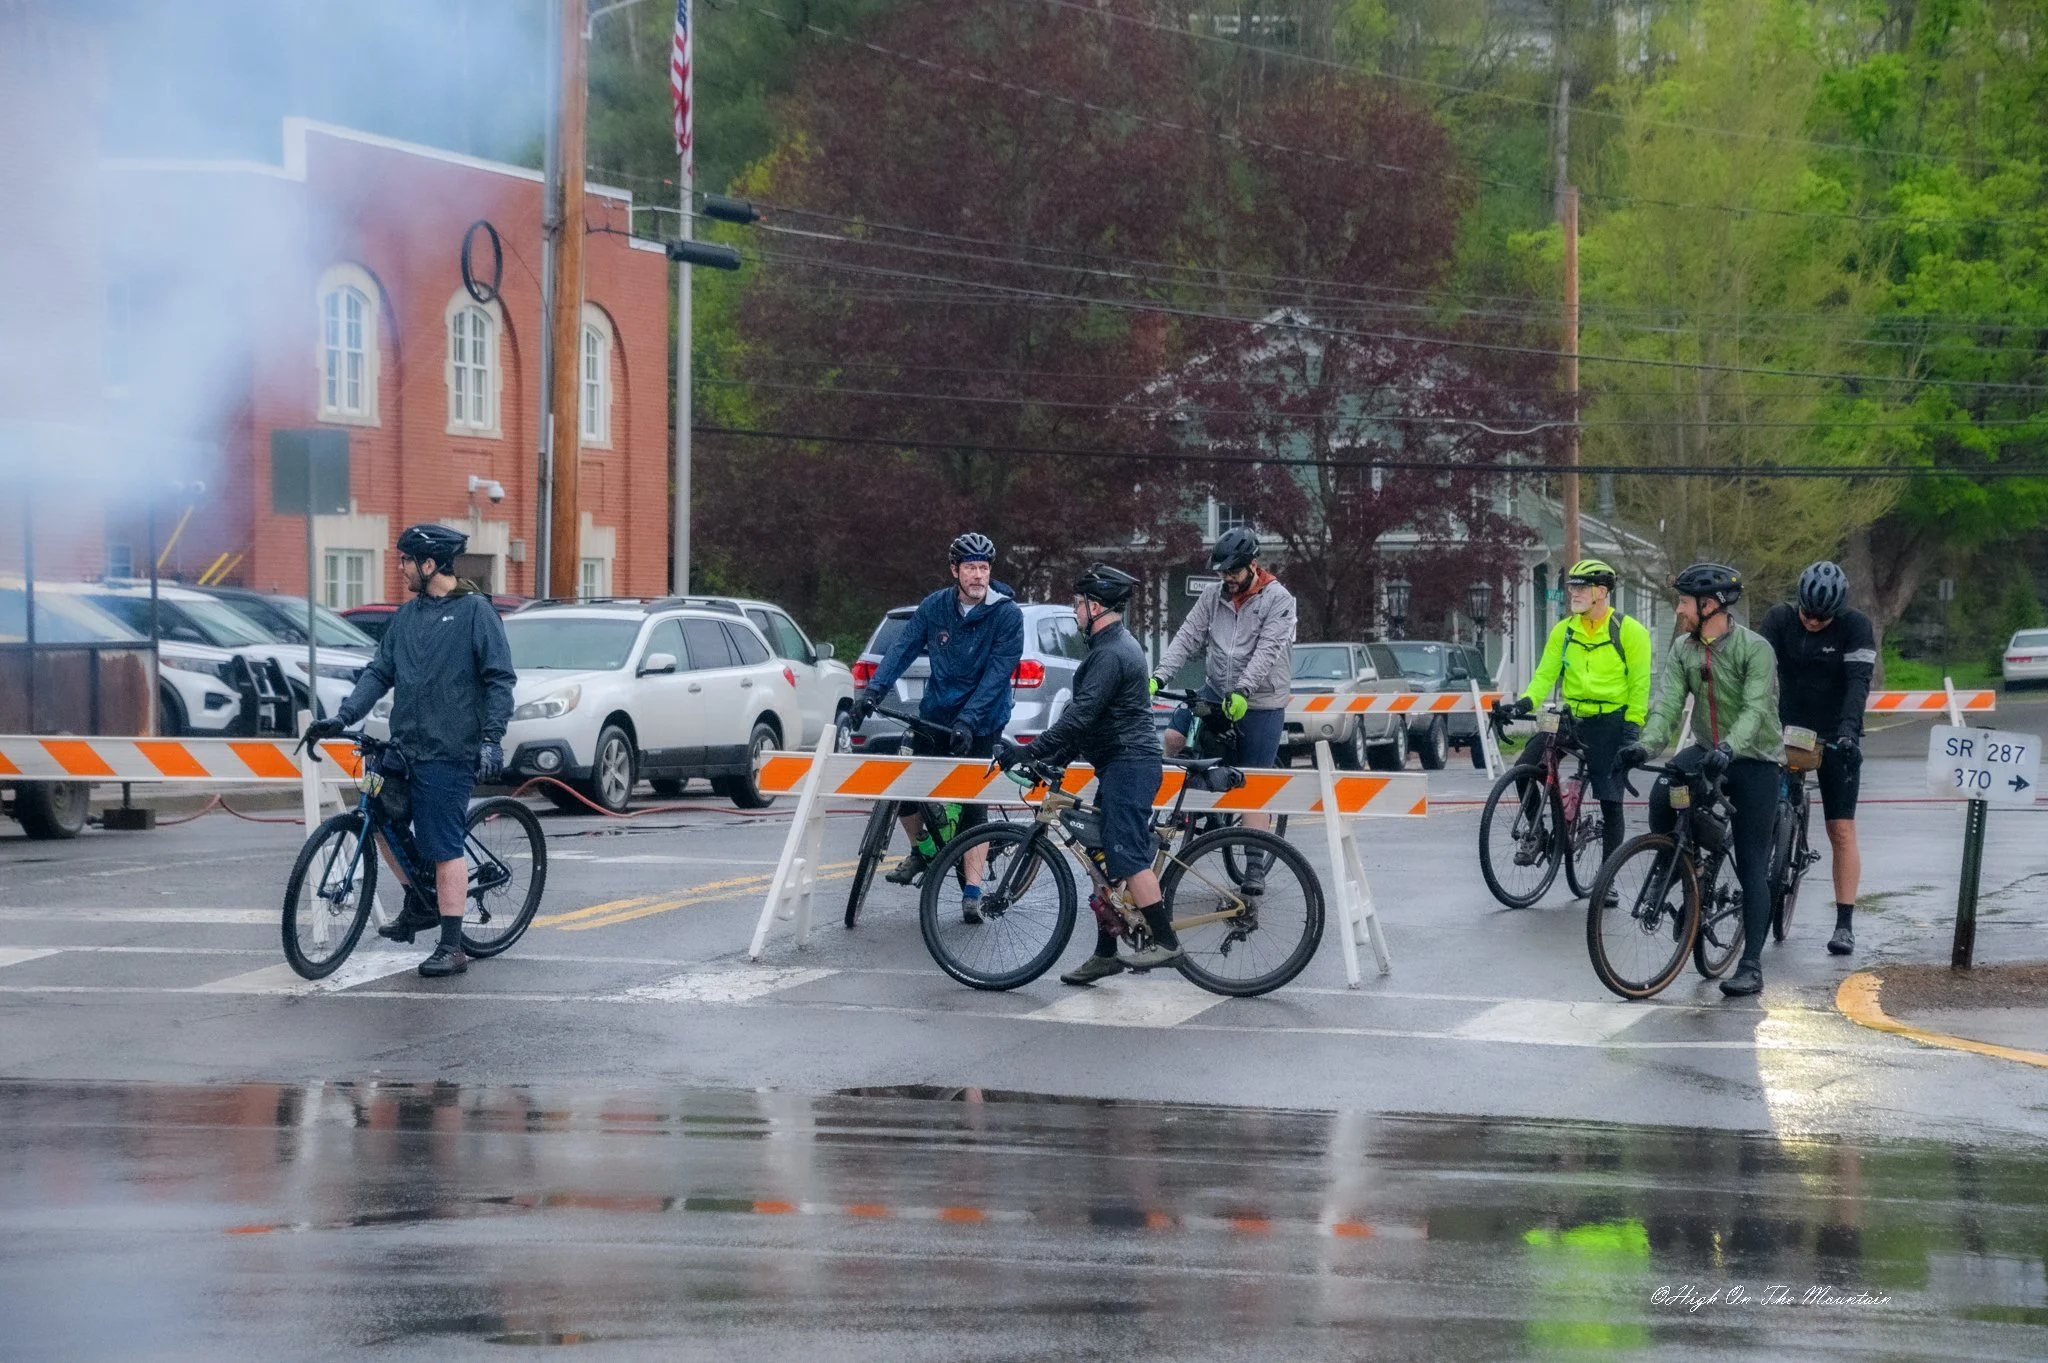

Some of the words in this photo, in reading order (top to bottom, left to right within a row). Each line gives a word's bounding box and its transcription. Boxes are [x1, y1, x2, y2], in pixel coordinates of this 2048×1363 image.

[1945, 737, 1974, 758] SR
[1987, 743, 2026, 765] 287
[1954, 768, 1992, 790] 370
